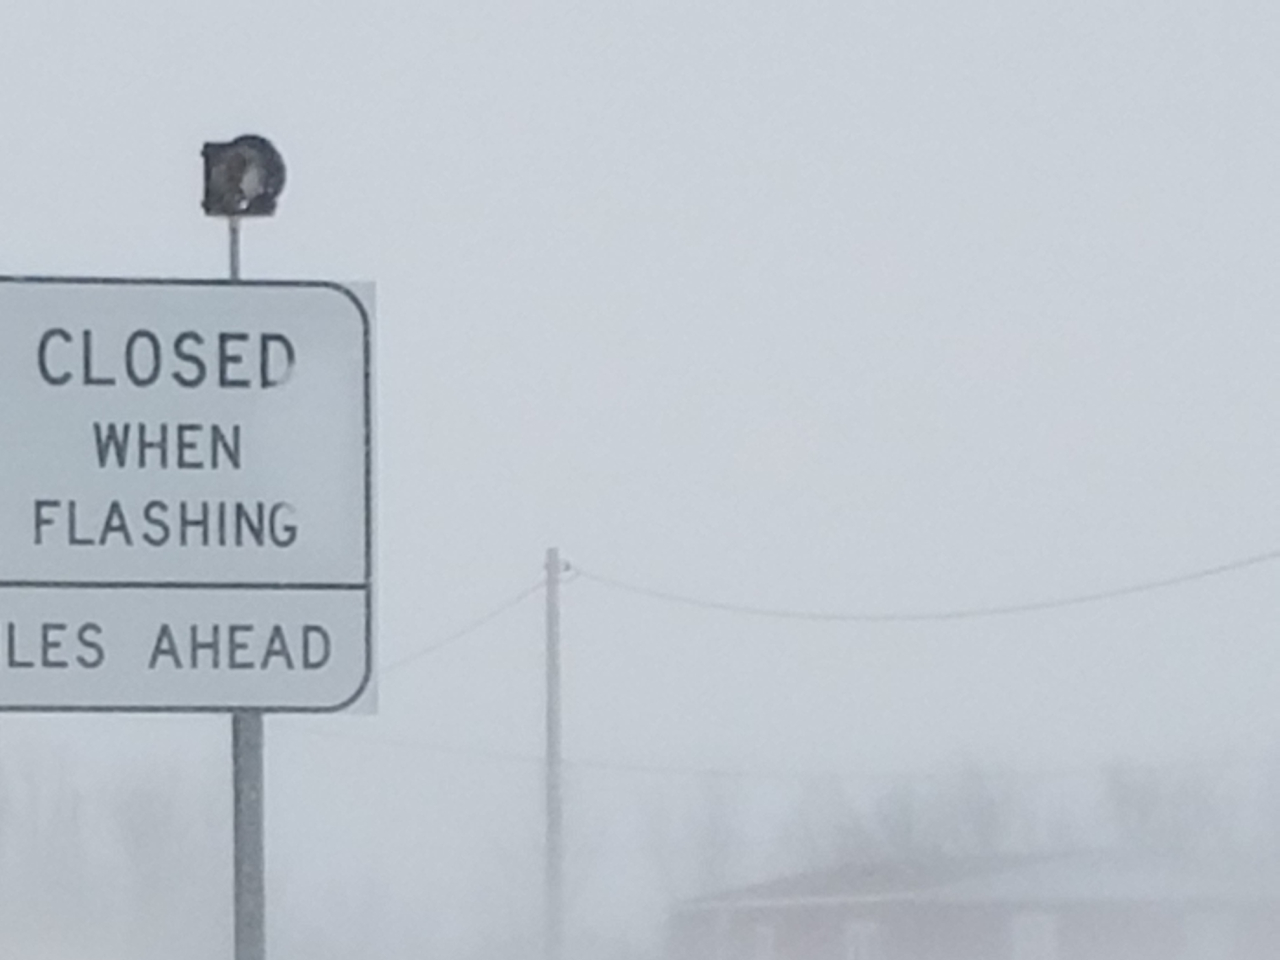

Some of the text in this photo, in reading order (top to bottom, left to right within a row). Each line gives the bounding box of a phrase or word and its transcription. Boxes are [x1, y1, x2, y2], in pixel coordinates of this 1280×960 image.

[38, 328, 296, 389] CLOSED
[94, 422, 242, 470] WHEN
[34, 500, 298, 548] FLASHING
[149, 624, 331, 671] AHEAD
